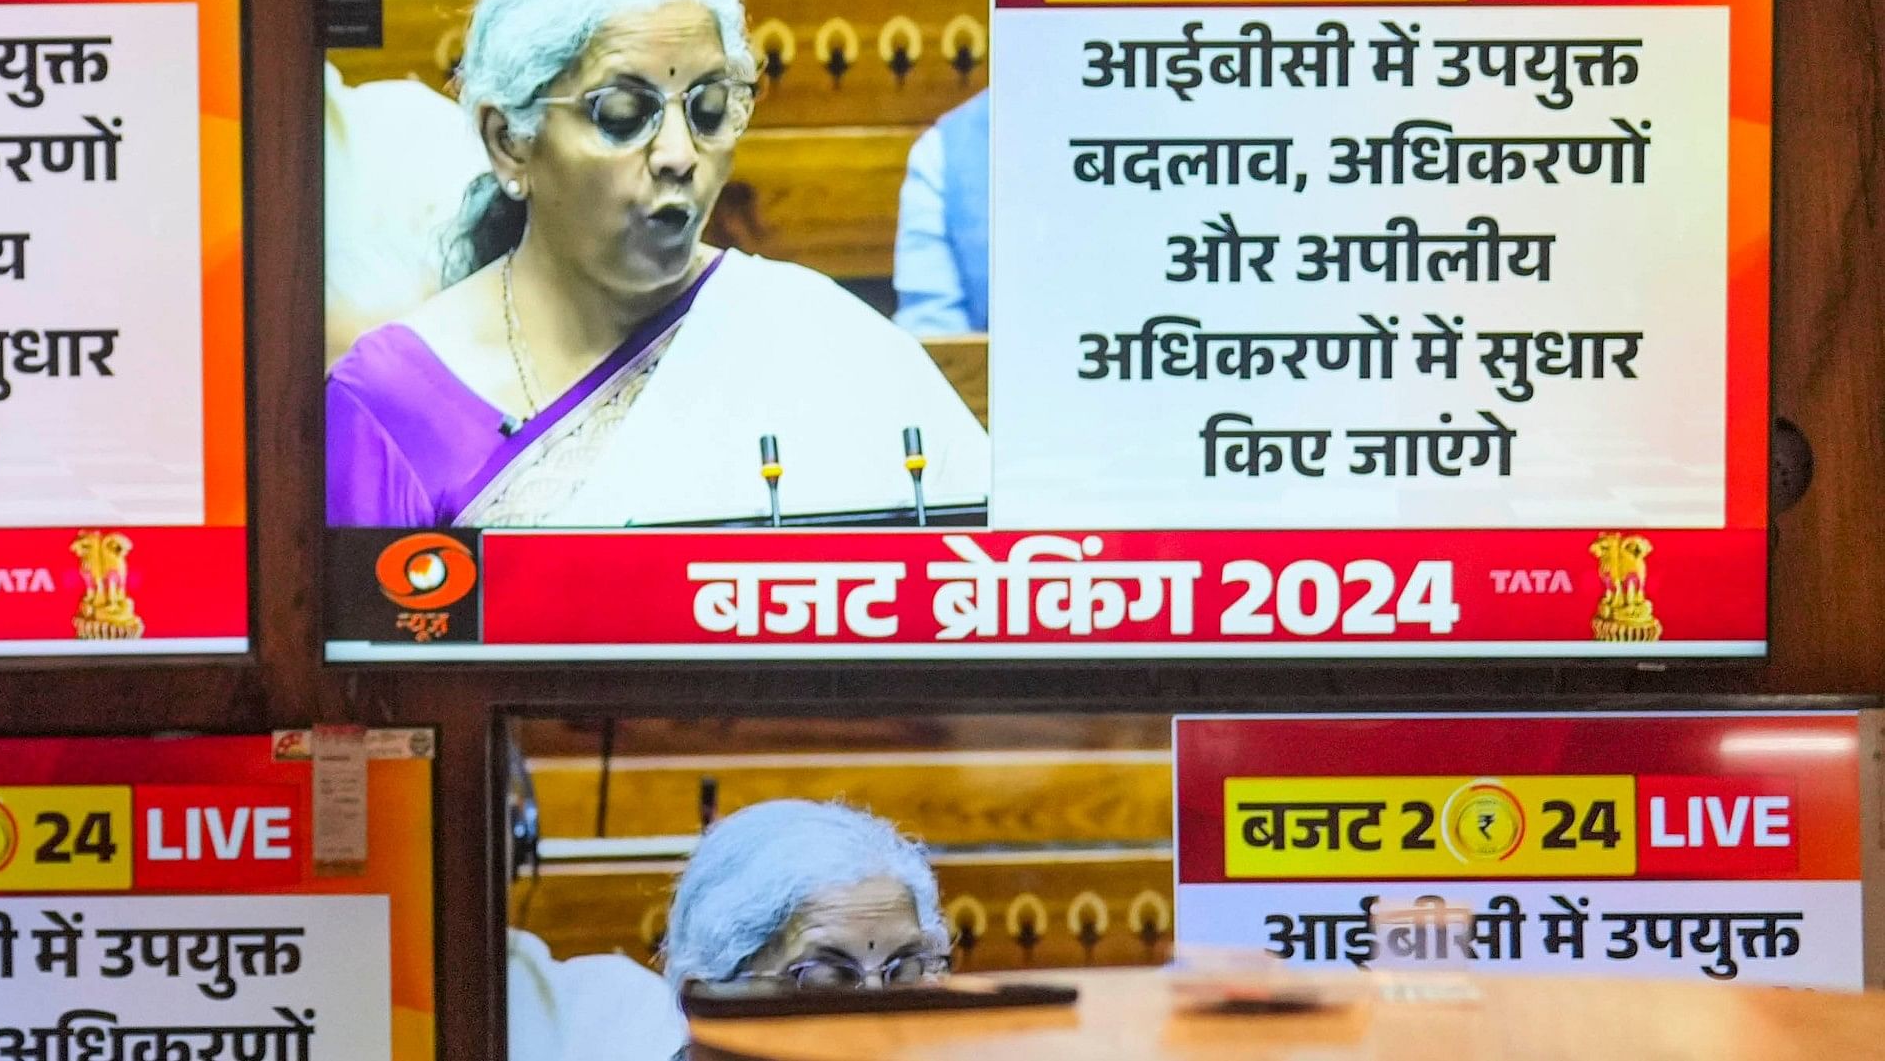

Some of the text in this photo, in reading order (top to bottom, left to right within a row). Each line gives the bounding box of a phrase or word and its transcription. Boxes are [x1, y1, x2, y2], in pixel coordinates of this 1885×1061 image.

[1082, 21, 1643, 111] आईबीसी में उपयुक्त
[1069, 118, 1652, 193] बदलाव, अधिकरणों
[1165, 213, 1557, 283] और अपीलीय
[1078, 313, 1644, 403] अधिकरणों में सुधार
[1198, 410, 1518, 478] किए जाएंगे
[686, 534, 1460, 640] बजट ब्रेकिंग 2024
[1490, 569, 1572, 593] TATA
[146, 806, 292, 861] LIVE
[1237, 801, 1387, 852] बजट
[1650, 795, 1791, 848] LIVE
[31, 910, 84, 978] में
[95, 926, 306, 1001] उपयुक्त
[1539, 895, 1590, 959] में
[1601, 911, 1804, 980] उपयुक्त
